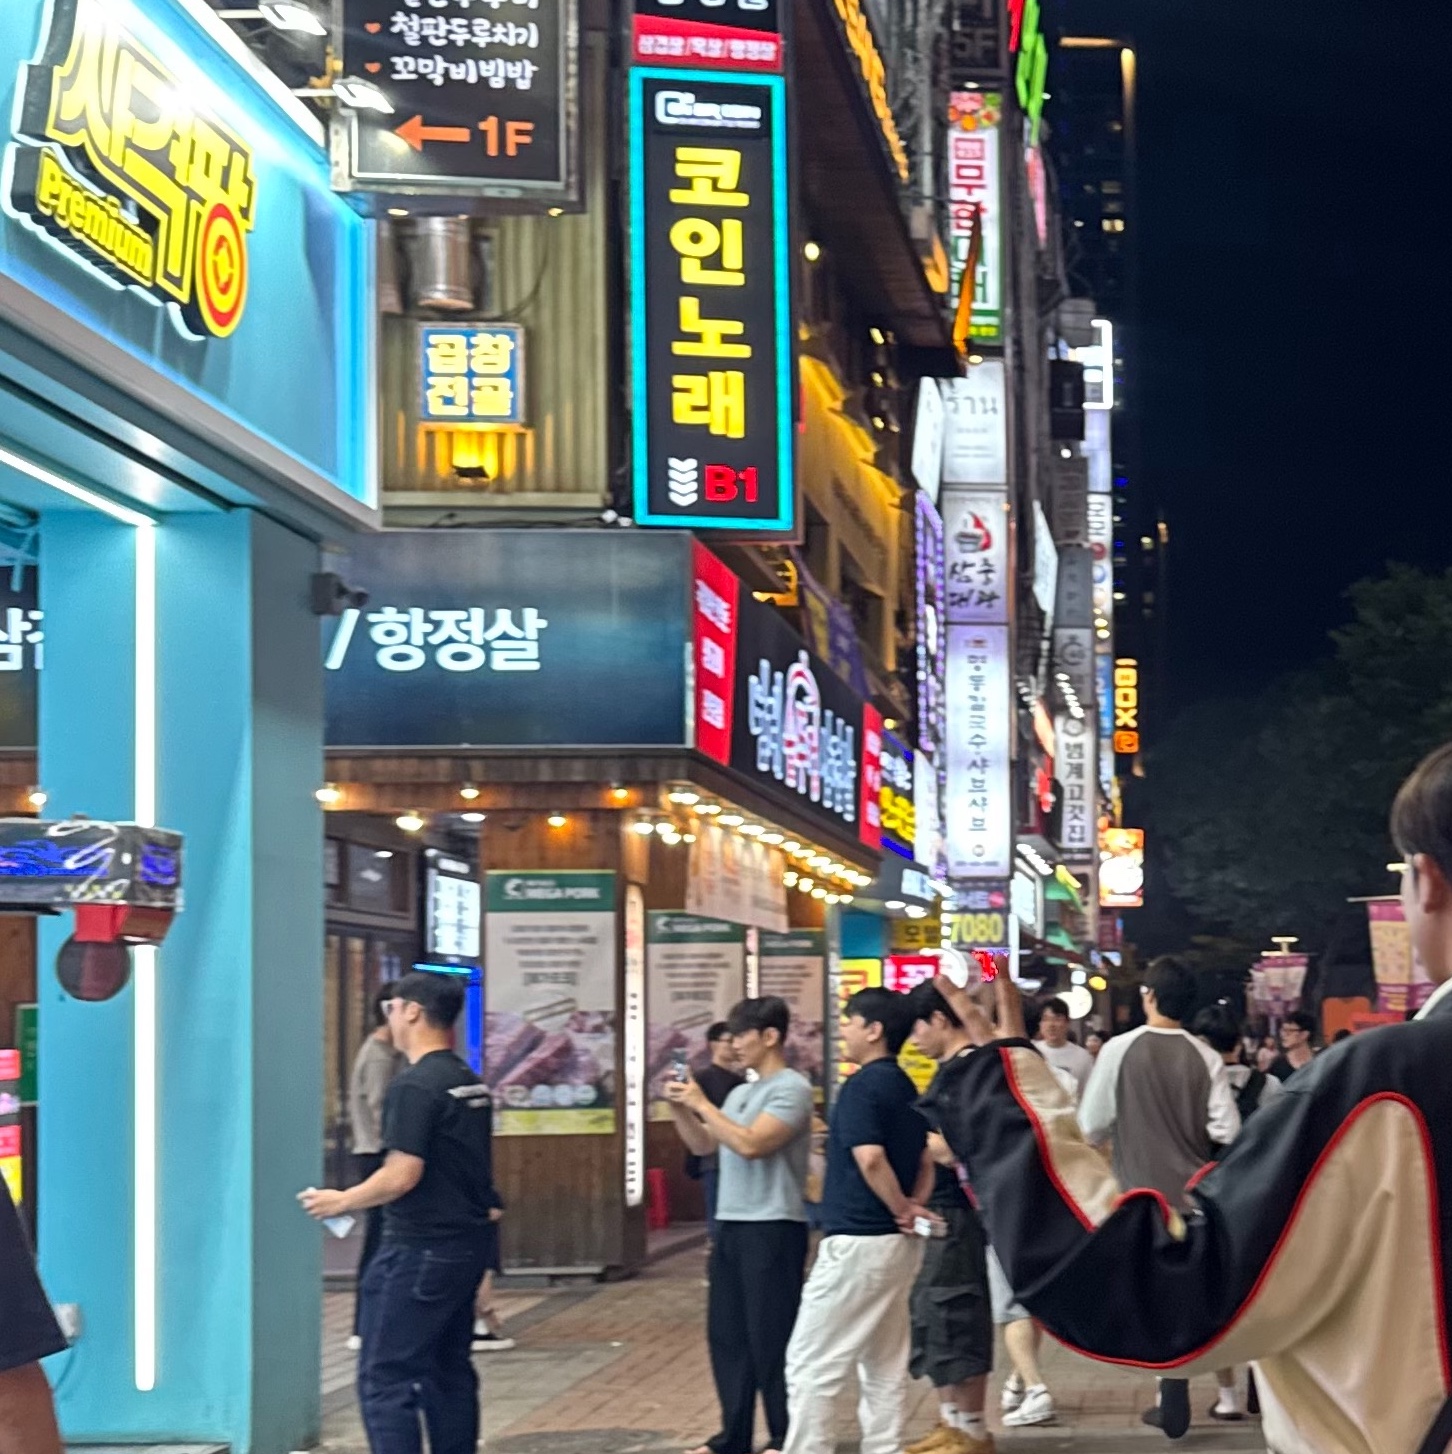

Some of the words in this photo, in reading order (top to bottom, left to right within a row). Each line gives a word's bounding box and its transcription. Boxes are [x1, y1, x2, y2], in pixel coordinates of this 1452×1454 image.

[389, 10, 540, 49] 철판두루치기
[389, 54, 540, 91] 꼬막비빔밥
[478, 115, 536, 157] 1F
[37, 150, 154, 286] Premium
[668, 146, 753, 440] 코인노래
[425, 333, 514, 375] 곱창
[425, 375, 514, 417] 전골
[705, 464, 758, 503] B1
[950, 913, 1004, 943] 7080
